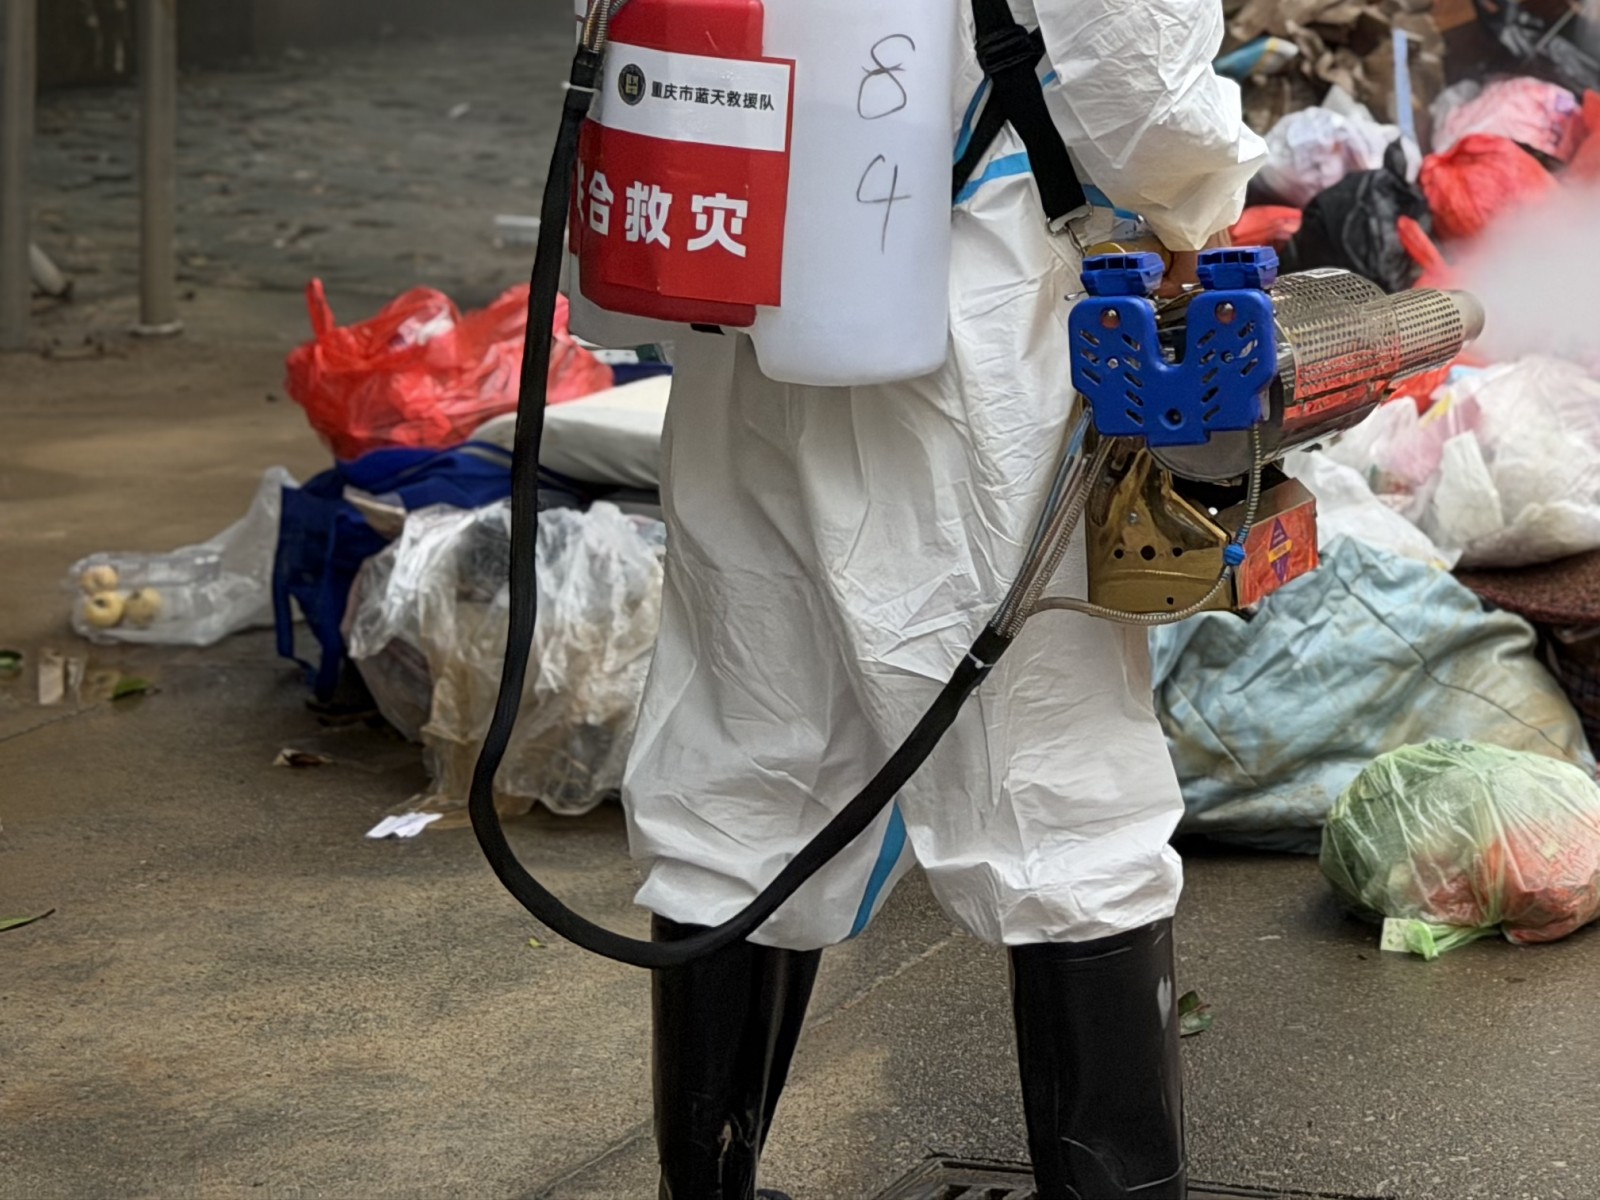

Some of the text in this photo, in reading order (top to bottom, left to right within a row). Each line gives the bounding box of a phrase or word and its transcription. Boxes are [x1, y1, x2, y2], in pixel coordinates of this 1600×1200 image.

[651, 80, 775, 111] 重庆市蓝天救援队
